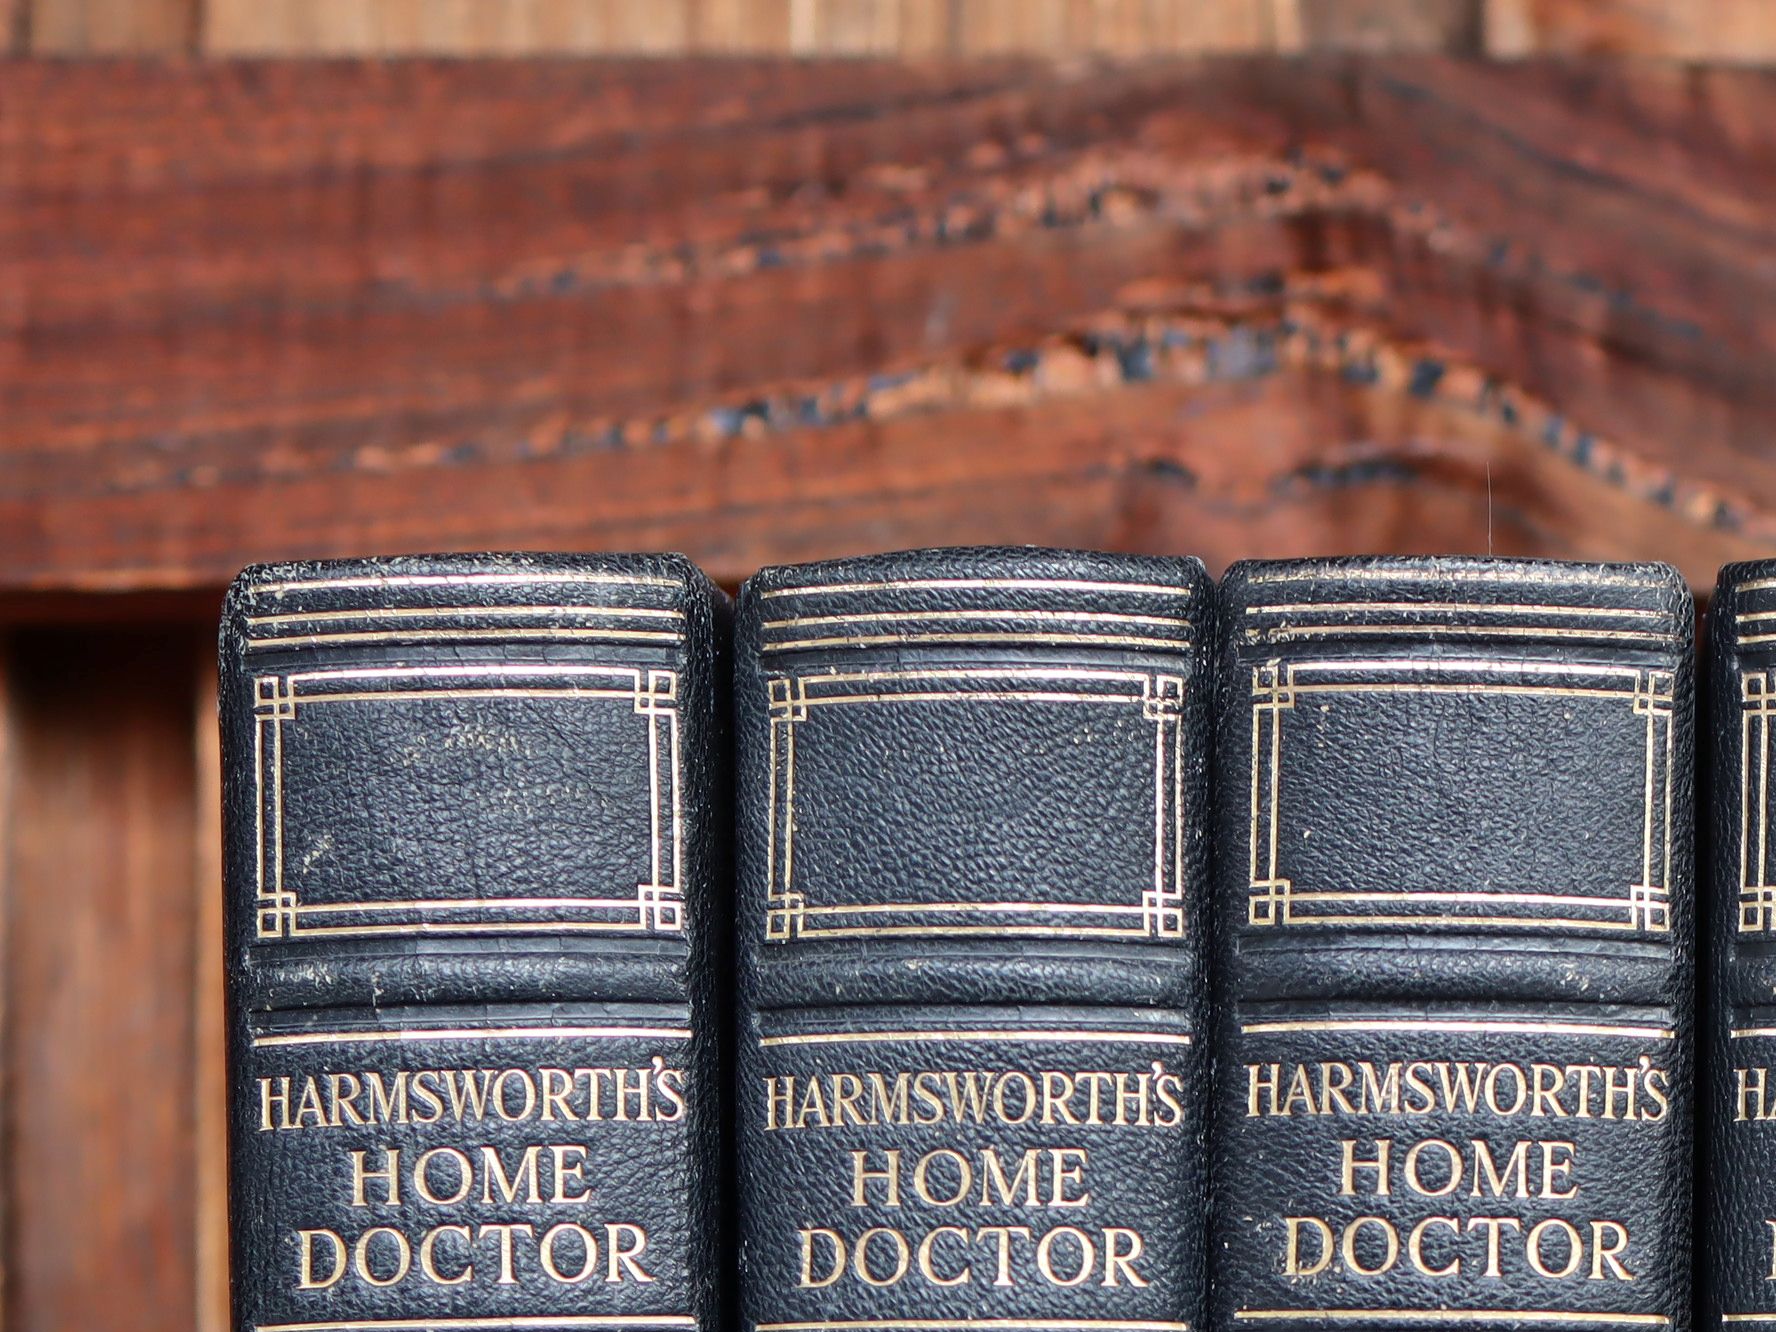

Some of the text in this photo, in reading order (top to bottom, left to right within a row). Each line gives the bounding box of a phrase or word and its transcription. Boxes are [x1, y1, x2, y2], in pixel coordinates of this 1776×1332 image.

[256, 1056, 688, 1134] HARMSWORTH'S
[762, 1062, 1185, 1132] HARMSWORTH'S
[1243, 1056, 1672, 1123] HARMSWORTH'S
[350, 1144, 595, 1208] HOME
[850, 1145, 1090, 1208] HOME
[1339, 1138, 1579, 1201] HOME
[296, 1221, 656, 1290] DOCTOR
[797, 1226, 1149, 1290] DOCTOR
[1283, 1215, 1636, 1281] DOCTOR
